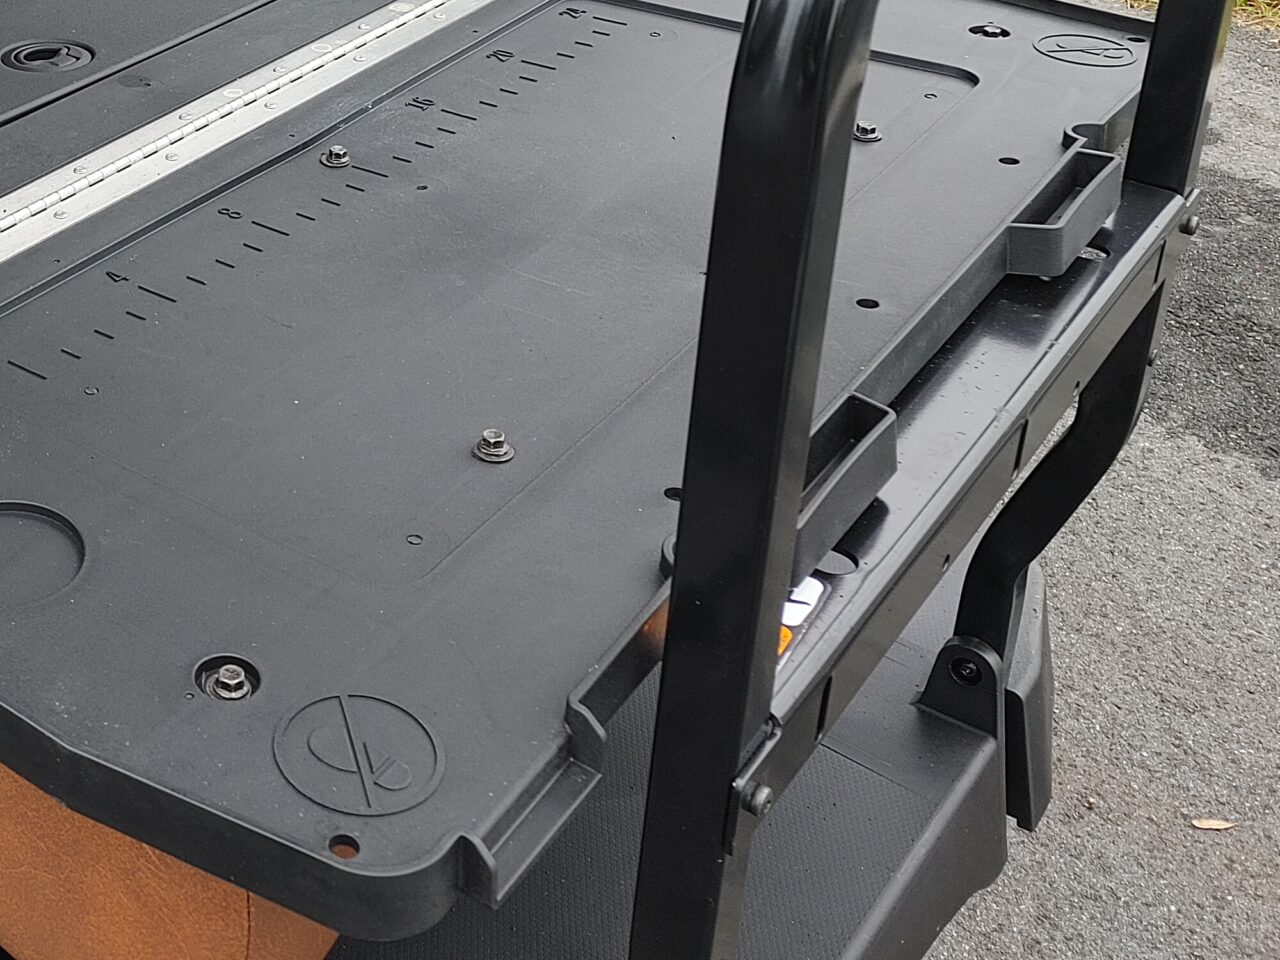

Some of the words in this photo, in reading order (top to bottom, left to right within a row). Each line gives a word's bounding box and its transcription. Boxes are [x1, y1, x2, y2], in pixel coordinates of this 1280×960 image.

[105, 271, 130, 283] 4
[217, 207, 243, 220] 8
[405, 96, 436, 112] 16
[485, 49, 515, 63] 20
[558, 7, 588, 20] 24
